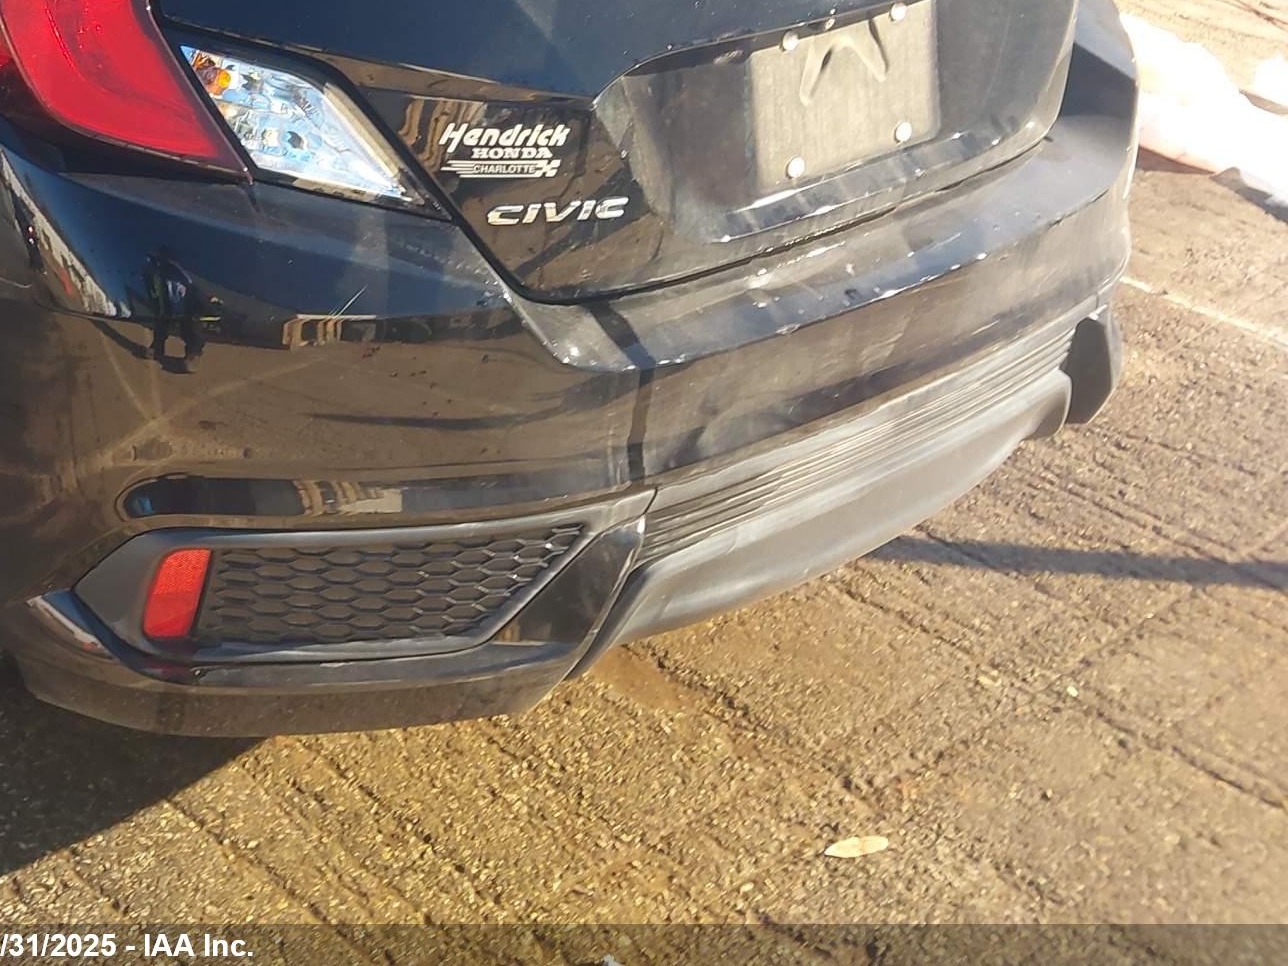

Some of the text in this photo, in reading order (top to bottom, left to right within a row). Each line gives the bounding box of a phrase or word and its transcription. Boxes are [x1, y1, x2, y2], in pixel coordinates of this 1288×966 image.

[438, 122, 571, 153] Hendrick
[471, 146, 554, 160] HONDA
[472, 163, 537, 175] CHARLOTTE
[487, 196, 630, 226] CIVIC
